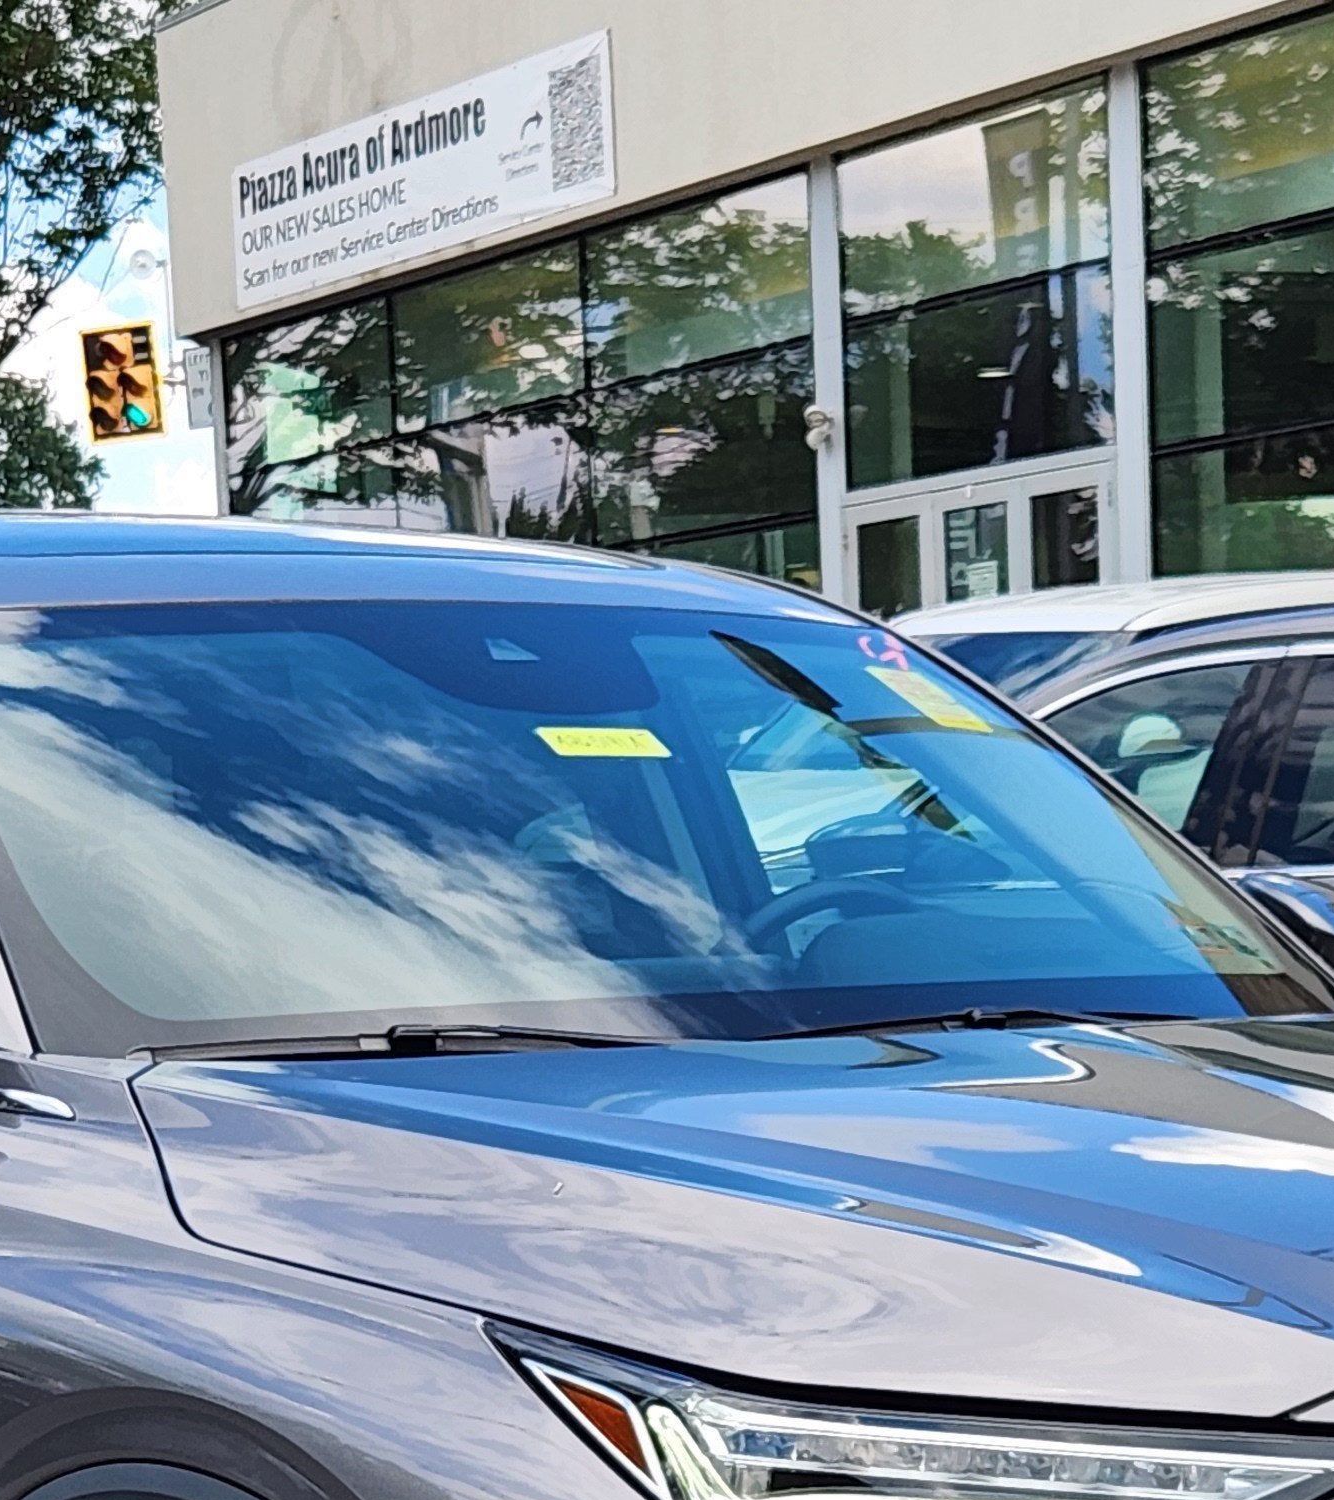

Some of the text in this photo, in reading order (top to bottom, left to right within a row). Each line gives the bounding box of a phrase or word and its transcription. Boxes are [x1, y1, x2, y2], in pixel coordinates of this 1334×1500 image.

[239, 165, 298, 219] Piazza
[302, 143, 360, 198] Acura
[366, 124, 385, 174] of
[391, 97, 486, 166] Ardmore
[242, 178, 406, 255] OUR NEW SALES HOME
[243, 195, 499, 290] Scan for our new Service Center Directions
